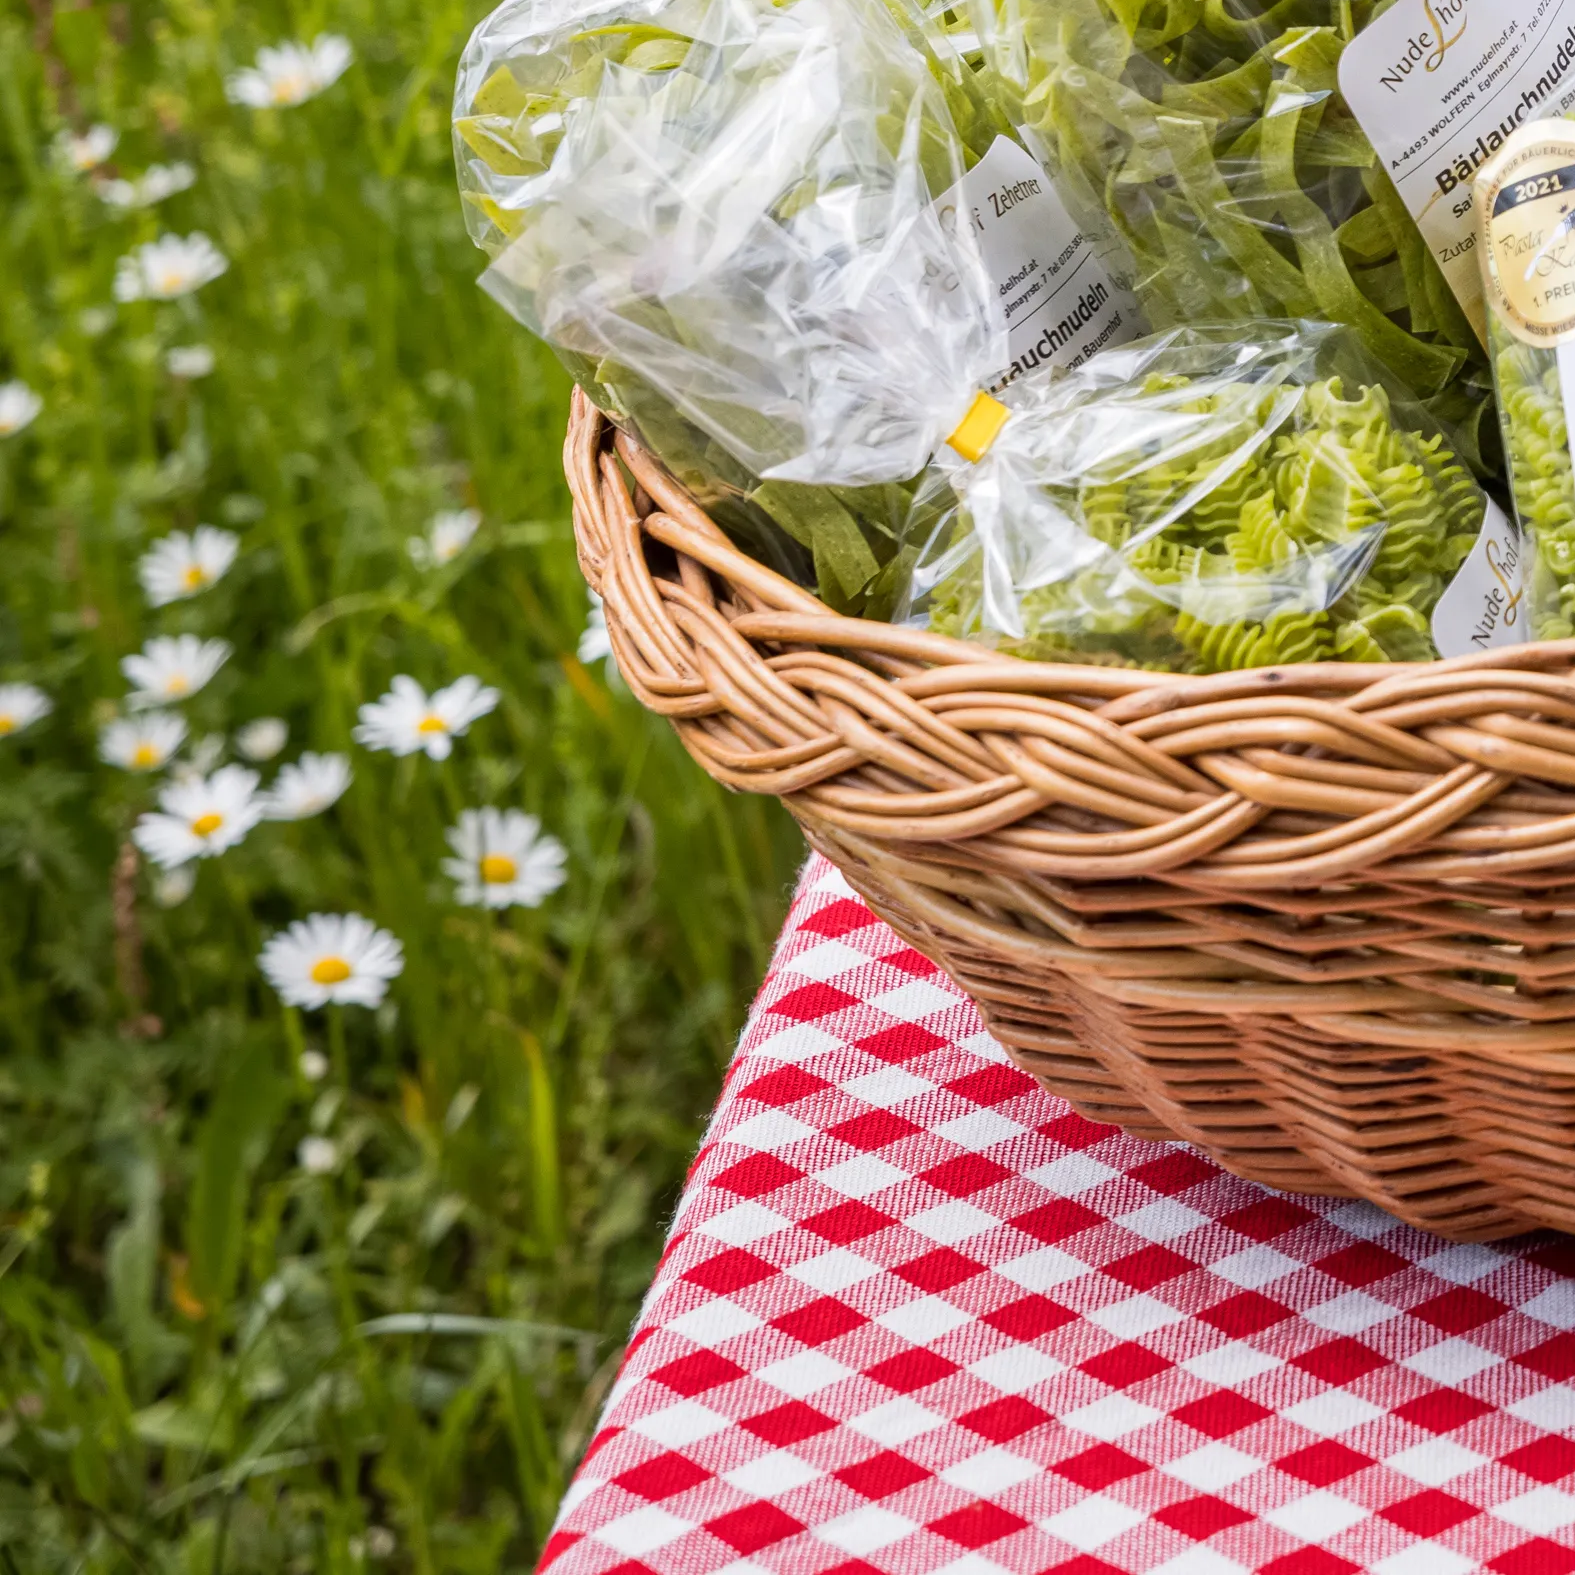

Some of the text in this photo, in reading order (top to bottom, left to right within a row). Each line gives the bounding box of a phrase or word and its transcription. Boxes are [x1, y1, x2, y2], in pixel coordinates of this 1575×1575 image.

[1440, 20, 1519, 105] www.nudelhof.at
[1391, 137, 1429, 170] A-4493
[1428, 92, 1475, 138] WOLFERN
[1478, 44, 1522, 92] Eglmayrstr.
[1520, 32, 1528, 43] 7
[1527, 16, 1541, 33] Tel:
[988, 177, 1042, 219] Zehetner
[1514, 174, 1564, 203] 2021
[1499, 227, 1545, 261] Pasta
[1041, 274, 1048, 284] 7
[1533, 295, 1543, 309] 1.
[1083, 312, 1123, 356] Bauernhof
